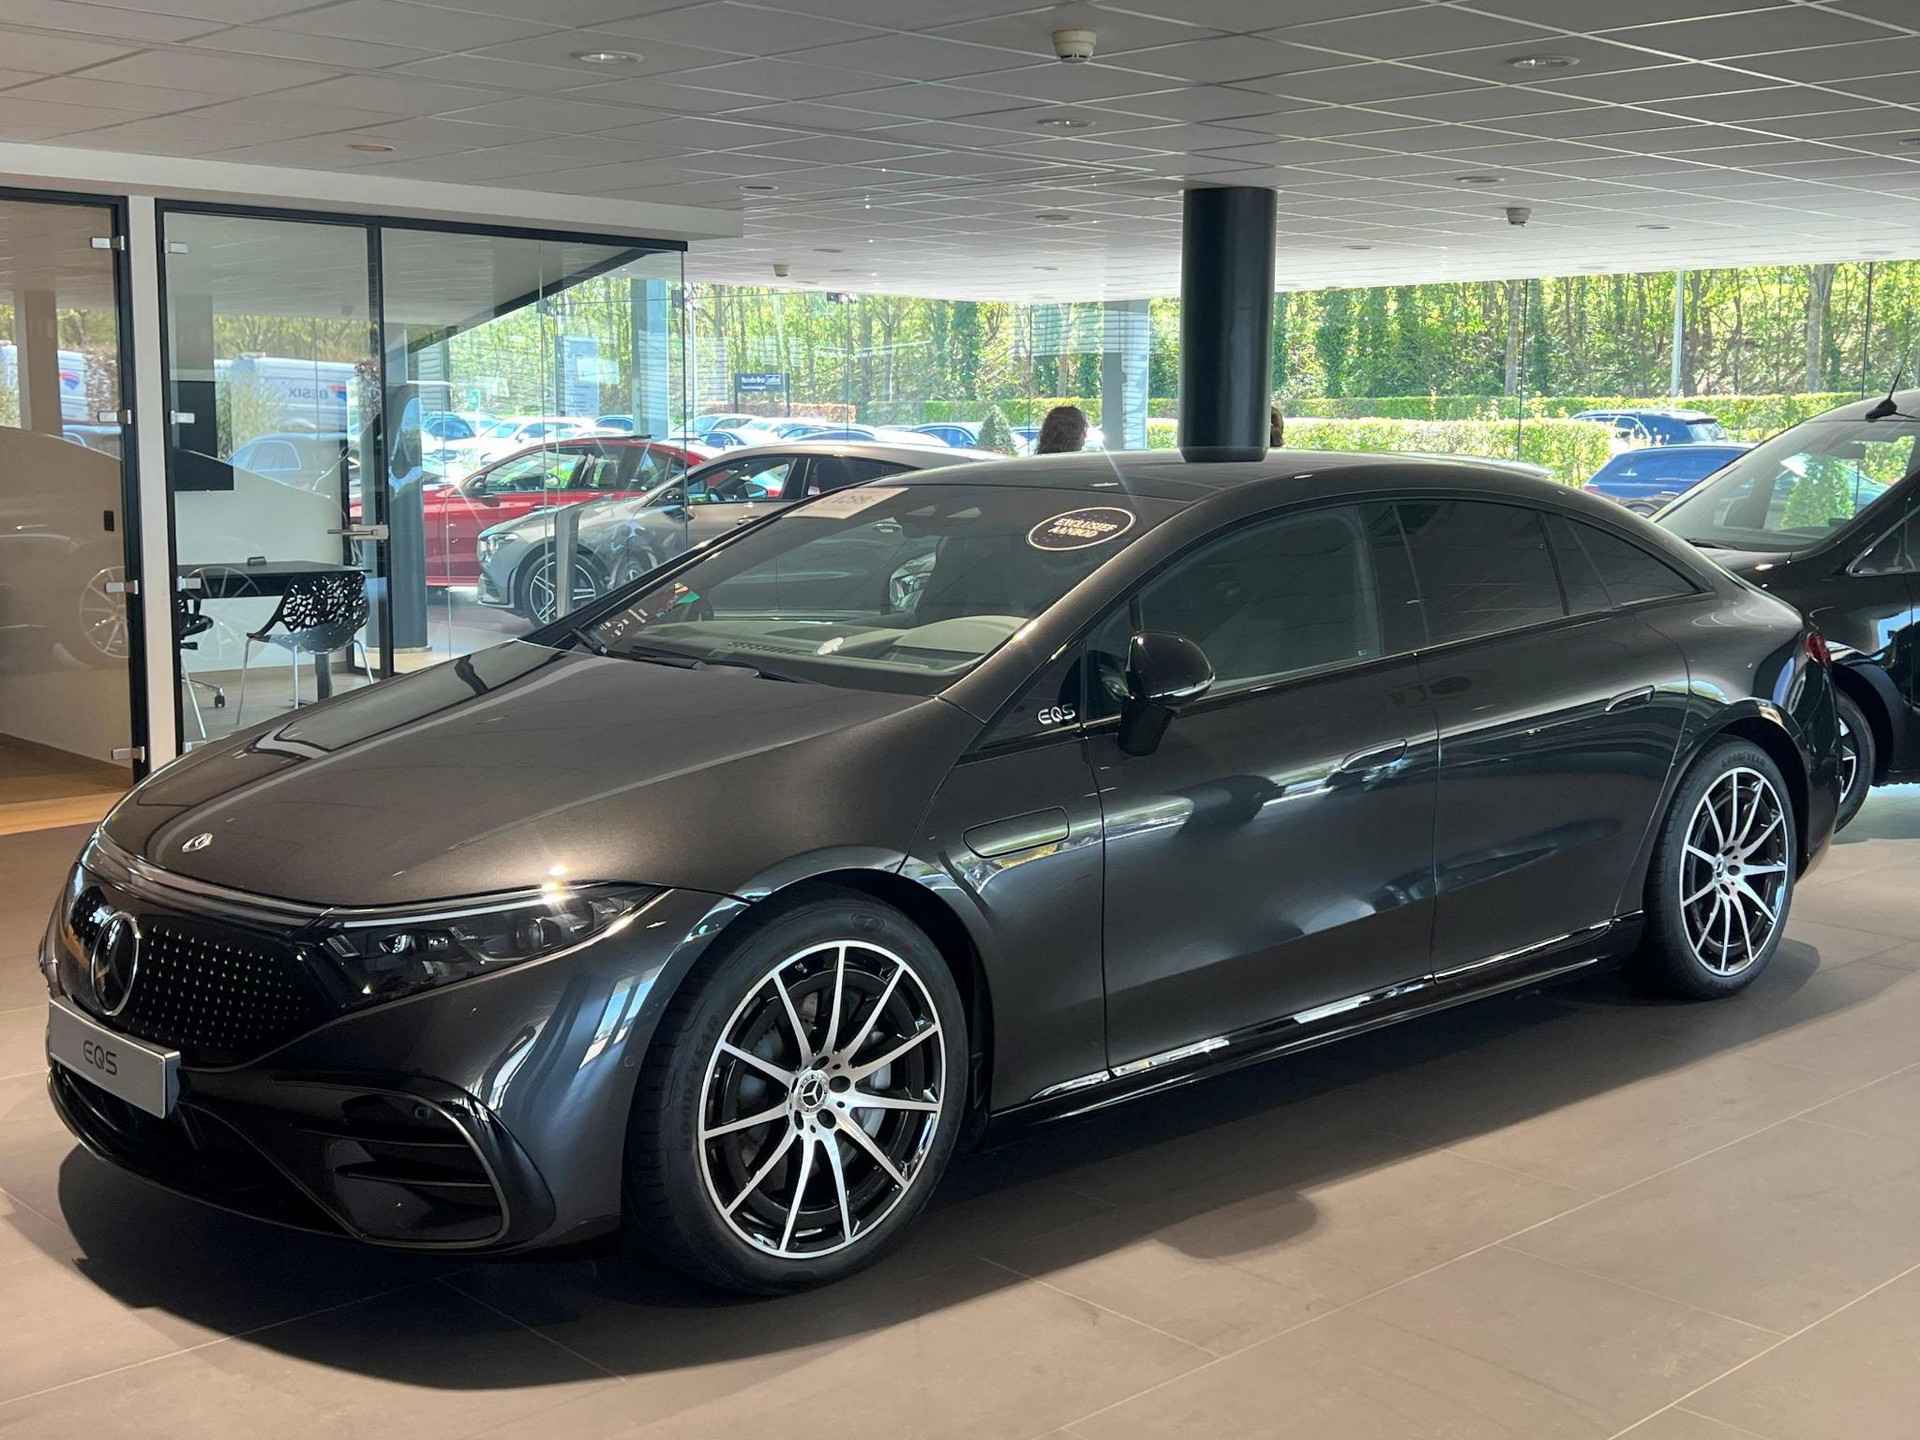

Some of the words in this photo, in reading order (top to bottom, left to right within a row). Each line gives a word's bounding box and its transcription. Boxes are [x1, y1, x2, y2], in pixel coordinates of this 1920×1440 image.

[1048, 526, 1099, 538] AANBOD
[1053, 518, 1118, 532] EXCLUSIEF
[1037, 703, 1076, 725] EQS
[82, 1039, 118, 1076] EQS
